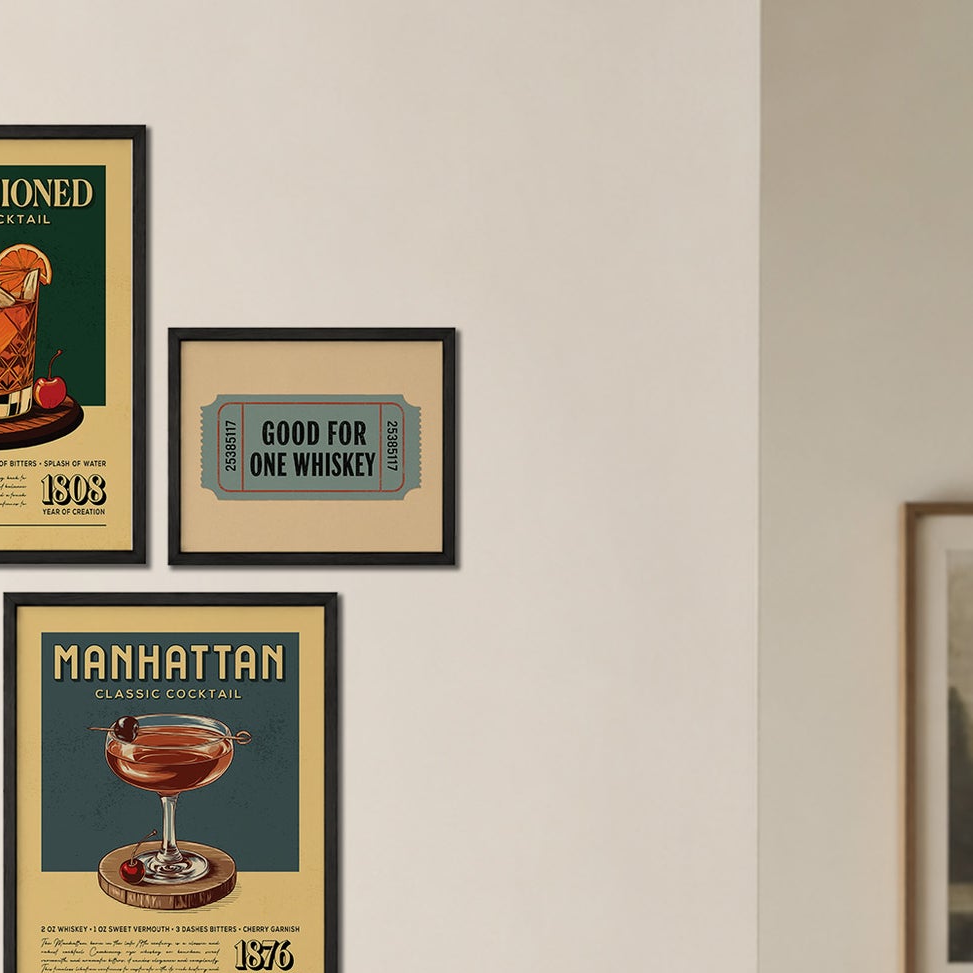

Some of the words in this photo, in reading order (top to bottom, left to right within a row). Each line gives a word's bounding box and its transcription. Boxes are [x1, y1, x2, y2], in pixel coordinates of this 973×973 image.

[225, 420, 237, 472] 25385117
[262, 420, 320, 446] GOOD
[328, 420, 367, 446] FOR
[387, 420, 399, 472] 25385117
[250, 452, 287, 477] ONE
[293, 452, 376, 477] WHISKEY
[41, 474, 107, 506] 1808
[53, 643, 286, 682] MANHATTAN
[95, 688, 161, 700] CLASSIC
[166, 688, 242, 700] COCKTAIL
[234, 939, 294, 971] 1876
